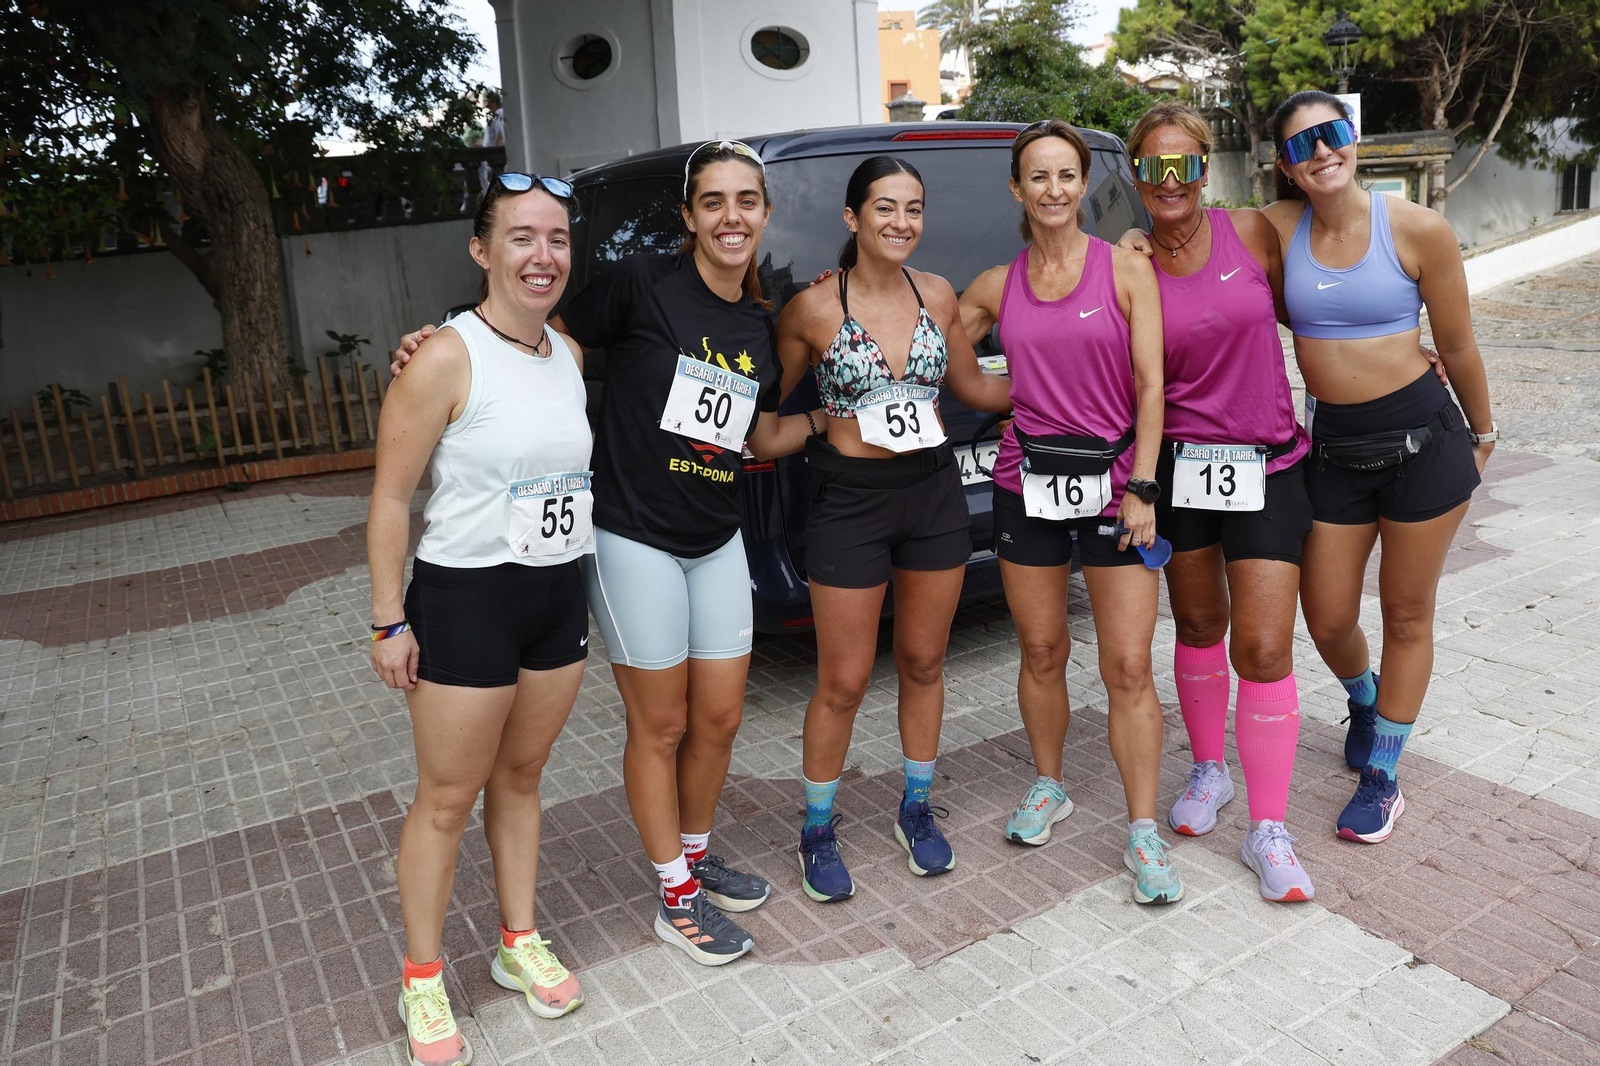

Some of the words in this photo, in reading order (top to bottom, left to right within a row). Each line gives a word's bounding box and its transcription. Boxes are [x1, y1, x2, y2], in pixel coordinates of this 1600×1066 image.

[715, 371, 731, 393] ELA
[732, 380, 752, 397] TARIFA
[893, 386, 909, 401] ELA
[695, 386, 732, 429] 50
[886, 401, 920, 437] 53
[1182, 448, 1209, 460] DESAFÍO
[1212, 448, 1231, 463] ELA
[1231, 450, 1257, 461] TARIFA
[517, 481, 552, 497] DESAFÍO
[552, 477, 568, 496] ELA
[567, 477, 585, 490] TARIFA
[1046, 475, 1084, 506] 16
[1199, 463, 1236, 497] 13
[541, 496, 574, 538] 55
